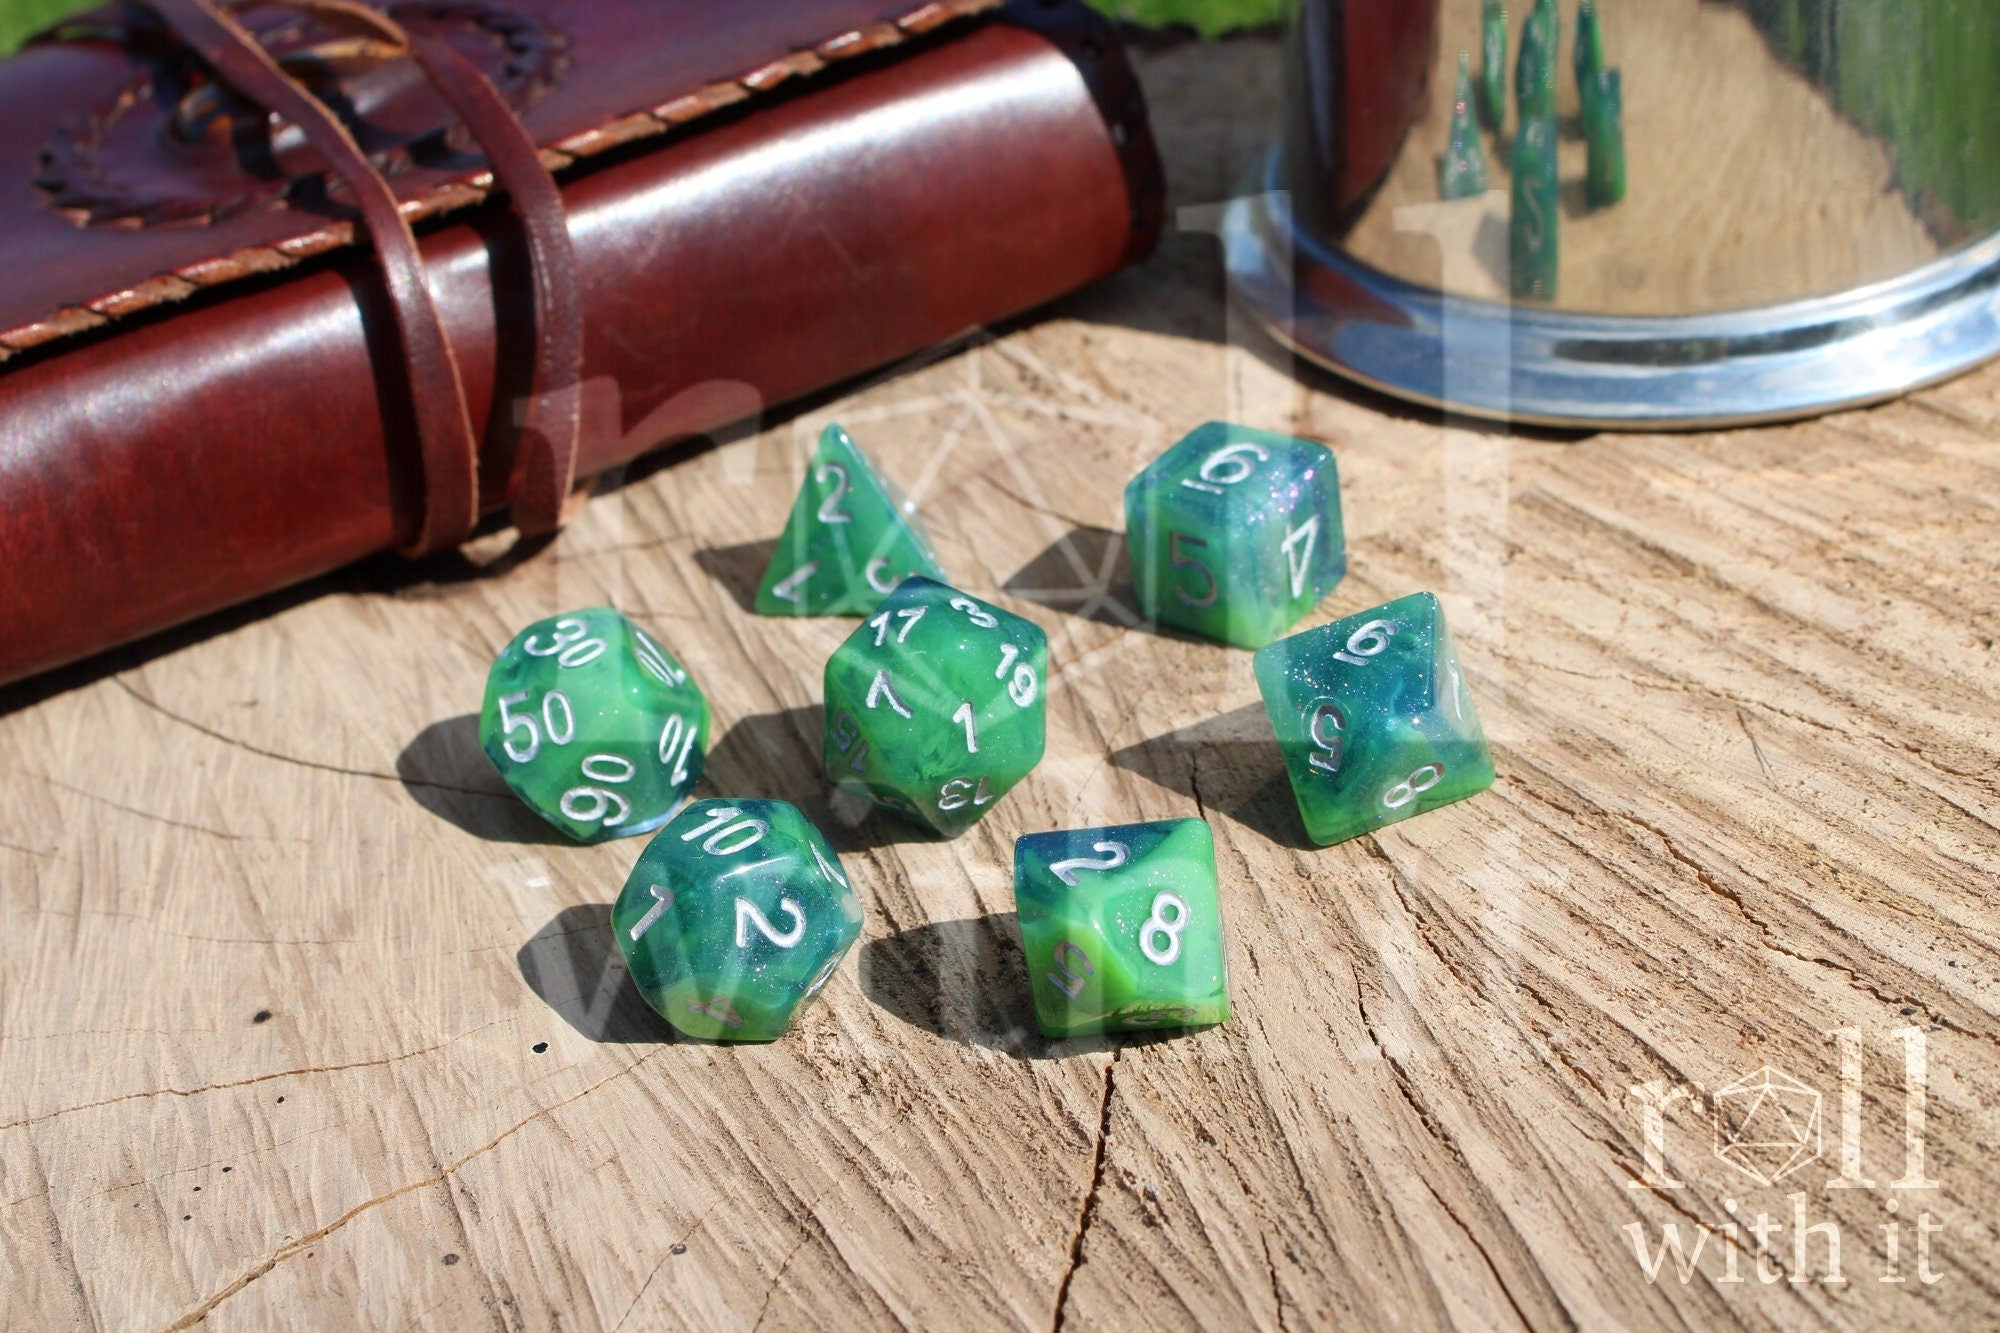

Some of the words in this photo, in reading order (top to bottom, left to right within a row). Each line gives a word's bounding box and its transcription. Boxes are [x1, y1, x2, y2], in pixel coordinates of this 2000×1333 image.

[816, 461, 852, 523] 2
[1168, 532, 1217, 609] 5
[1281, 515, 1320, 598] 4
[869, 606, 928, 647] 17
[949, 597, 998, 629] 3
[523, 618, 606, 667] 30
[995, 643, 1038, 707] 19
[498, 691, 576, 763] 50
[953, 701, 979, 754] 1
[1309, 704, 1346, 772] 5
[560, 754, 635, 827] 90
[1384, 762, 1445, 809] 8
[681, 807, 769, 856] 10
[1050, 842, 1130, 887] 2
[734, 895, 807, 948] 2
[1139, 890, 1192, 966] 8
[1047, 941, 1094, 999] 5
